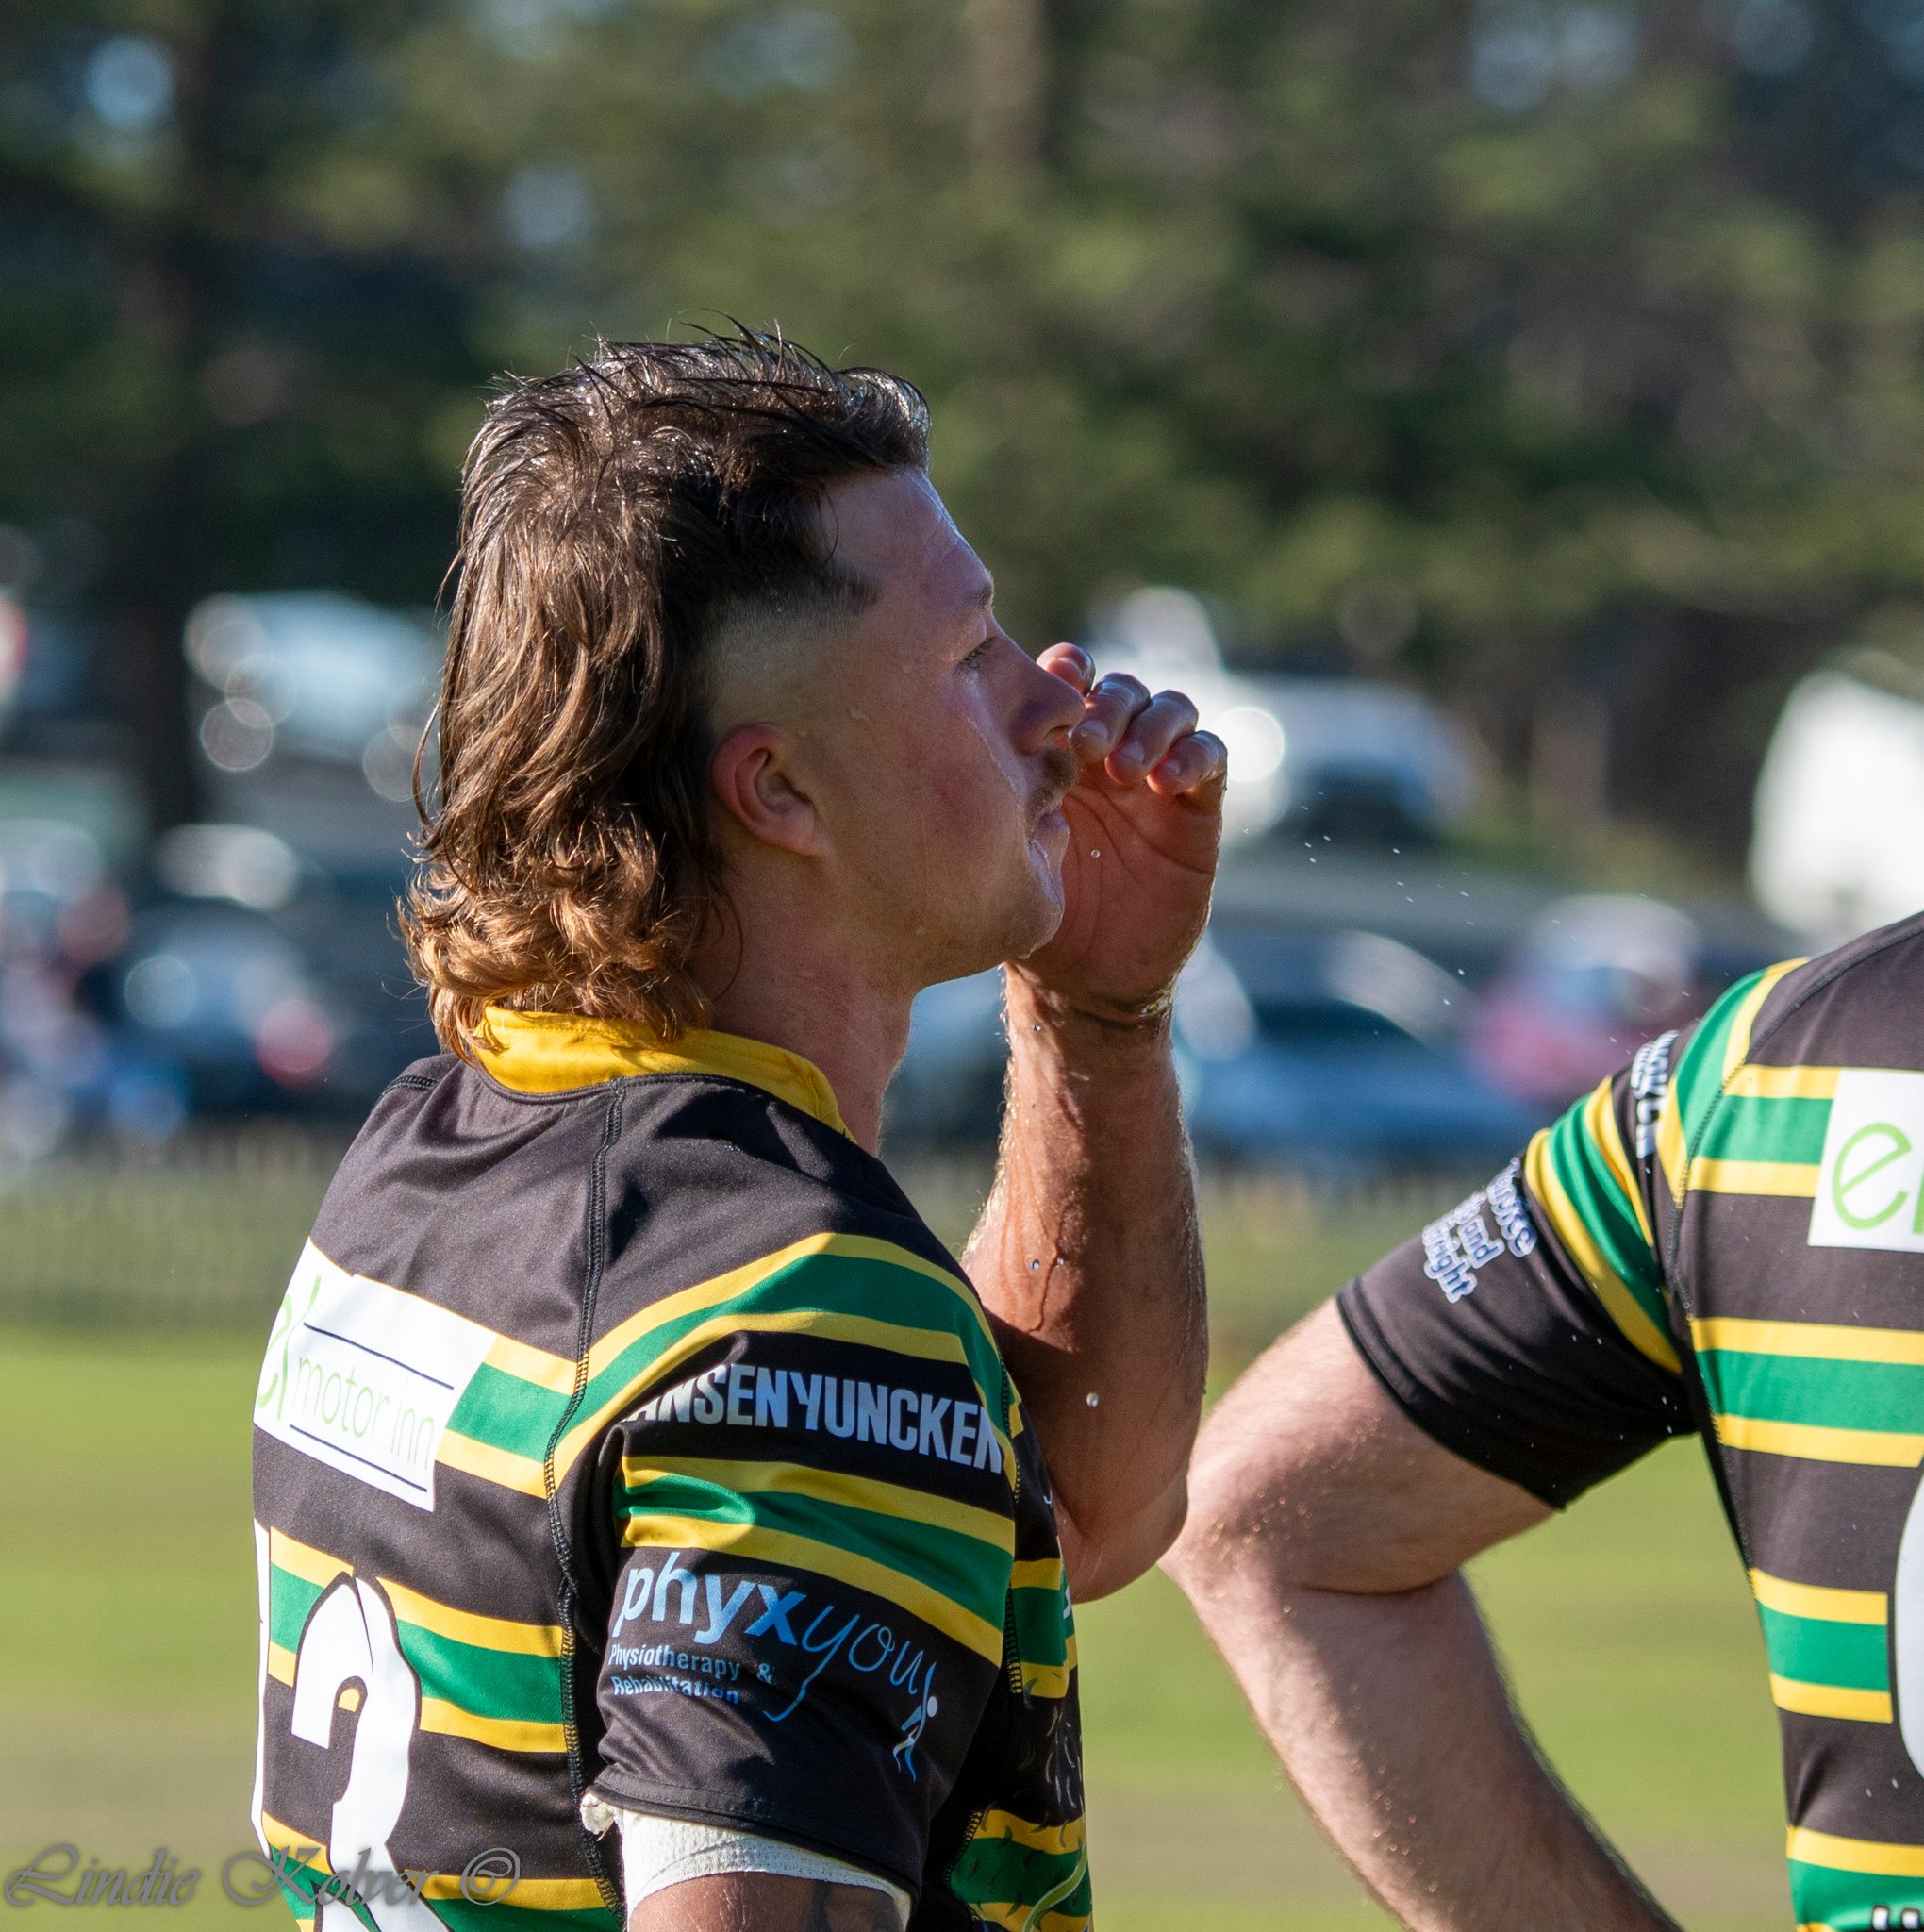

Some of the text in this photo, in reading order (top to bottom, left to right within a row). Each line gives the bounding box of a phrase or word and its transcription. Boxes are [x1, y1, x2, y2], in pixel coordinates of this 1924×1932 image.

[1461, 1218, 1502, 1265] and
[292, 1356, 435, 1471] motor inn
[608, 1644, 772, 1685] Physiotherapy &
